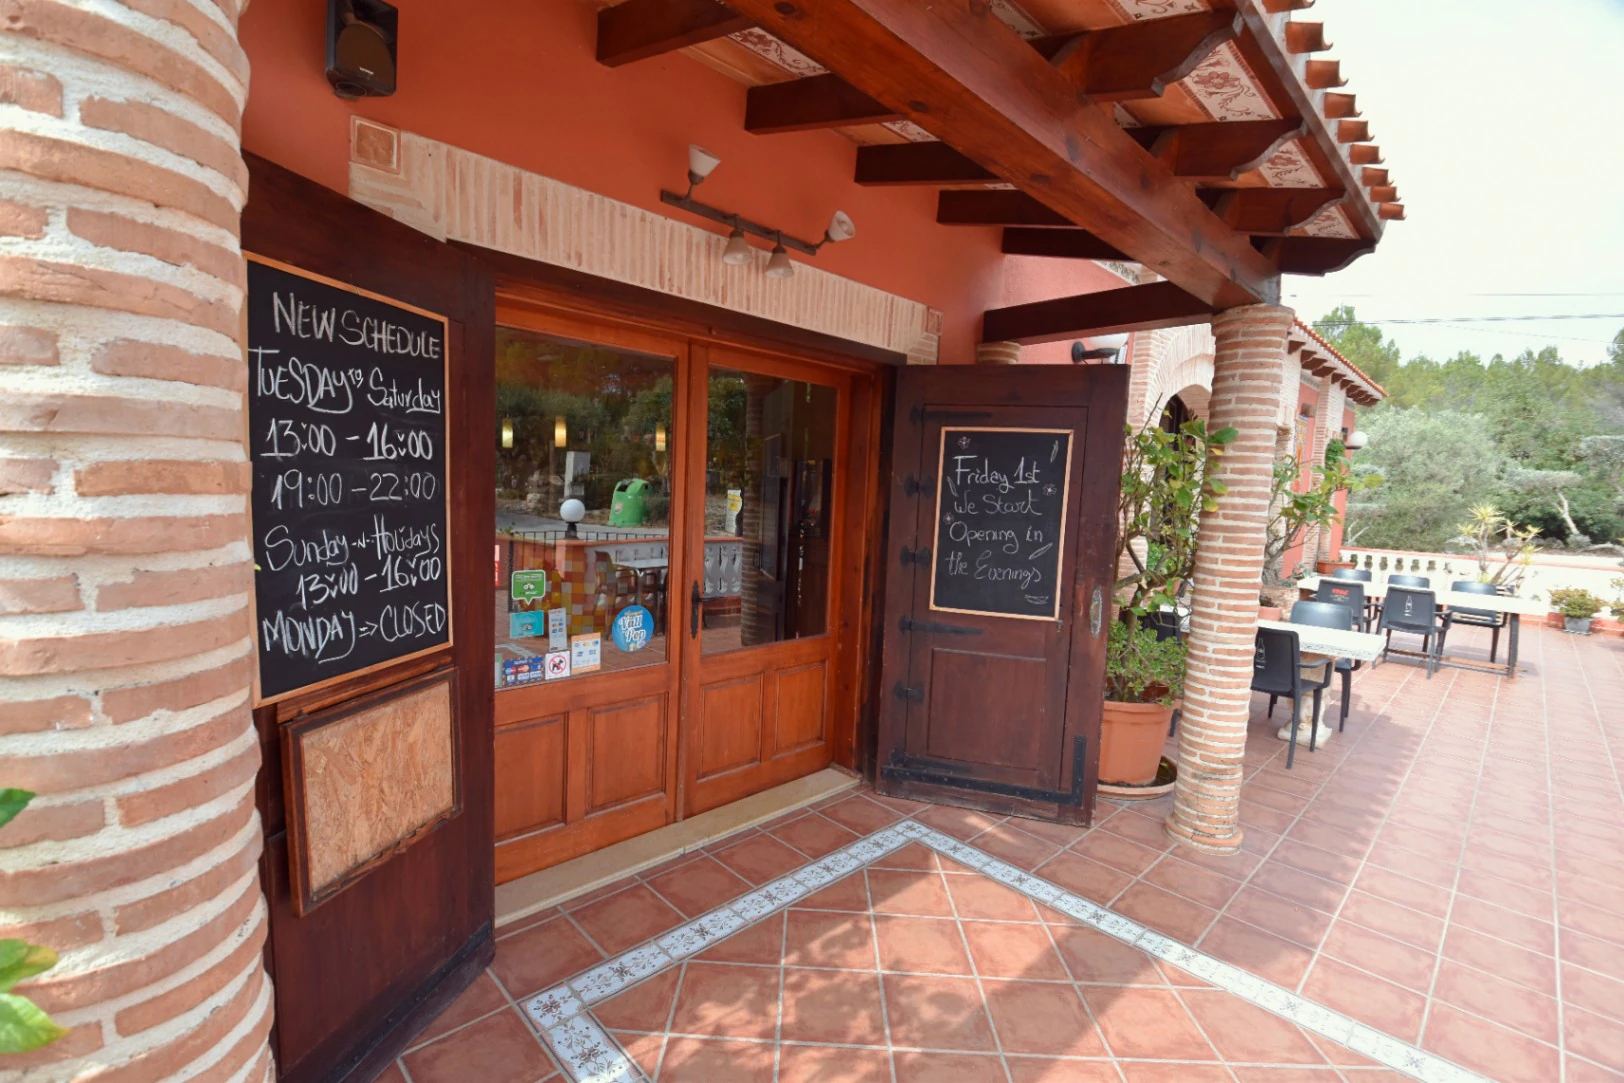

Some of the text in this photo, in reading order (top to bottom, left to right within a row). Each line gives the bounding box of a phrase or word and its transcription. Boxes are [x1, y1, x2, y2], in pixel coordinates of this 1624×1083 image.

[273, 291, 440, 359] NEW SCHEDULE
[248, 346, 353, 414] TUESDAY
[367, 366, 440, 414] Saturday
[260, 418, 336, 457] 13:00
[362, 421, 433, 460] 16:00
[271, 469, 343, 510] 19:00
[369, 472, 436, 501] 22:00
[952, 455, 1041, 493] Friday 1st
[954, 489, 1043, 516] We Start
[264, 525, 349, 571] Sunday
[370, 513, 440, 560] Holidays
[950, 520, 1043, 555] Opening in
[296, 562, 359, 610] 13:00
[379, 554, 441, 593] 16:00
[945, 550, 969, 576] the
[262, 601, 446, 664] MONDAY CLOSED
